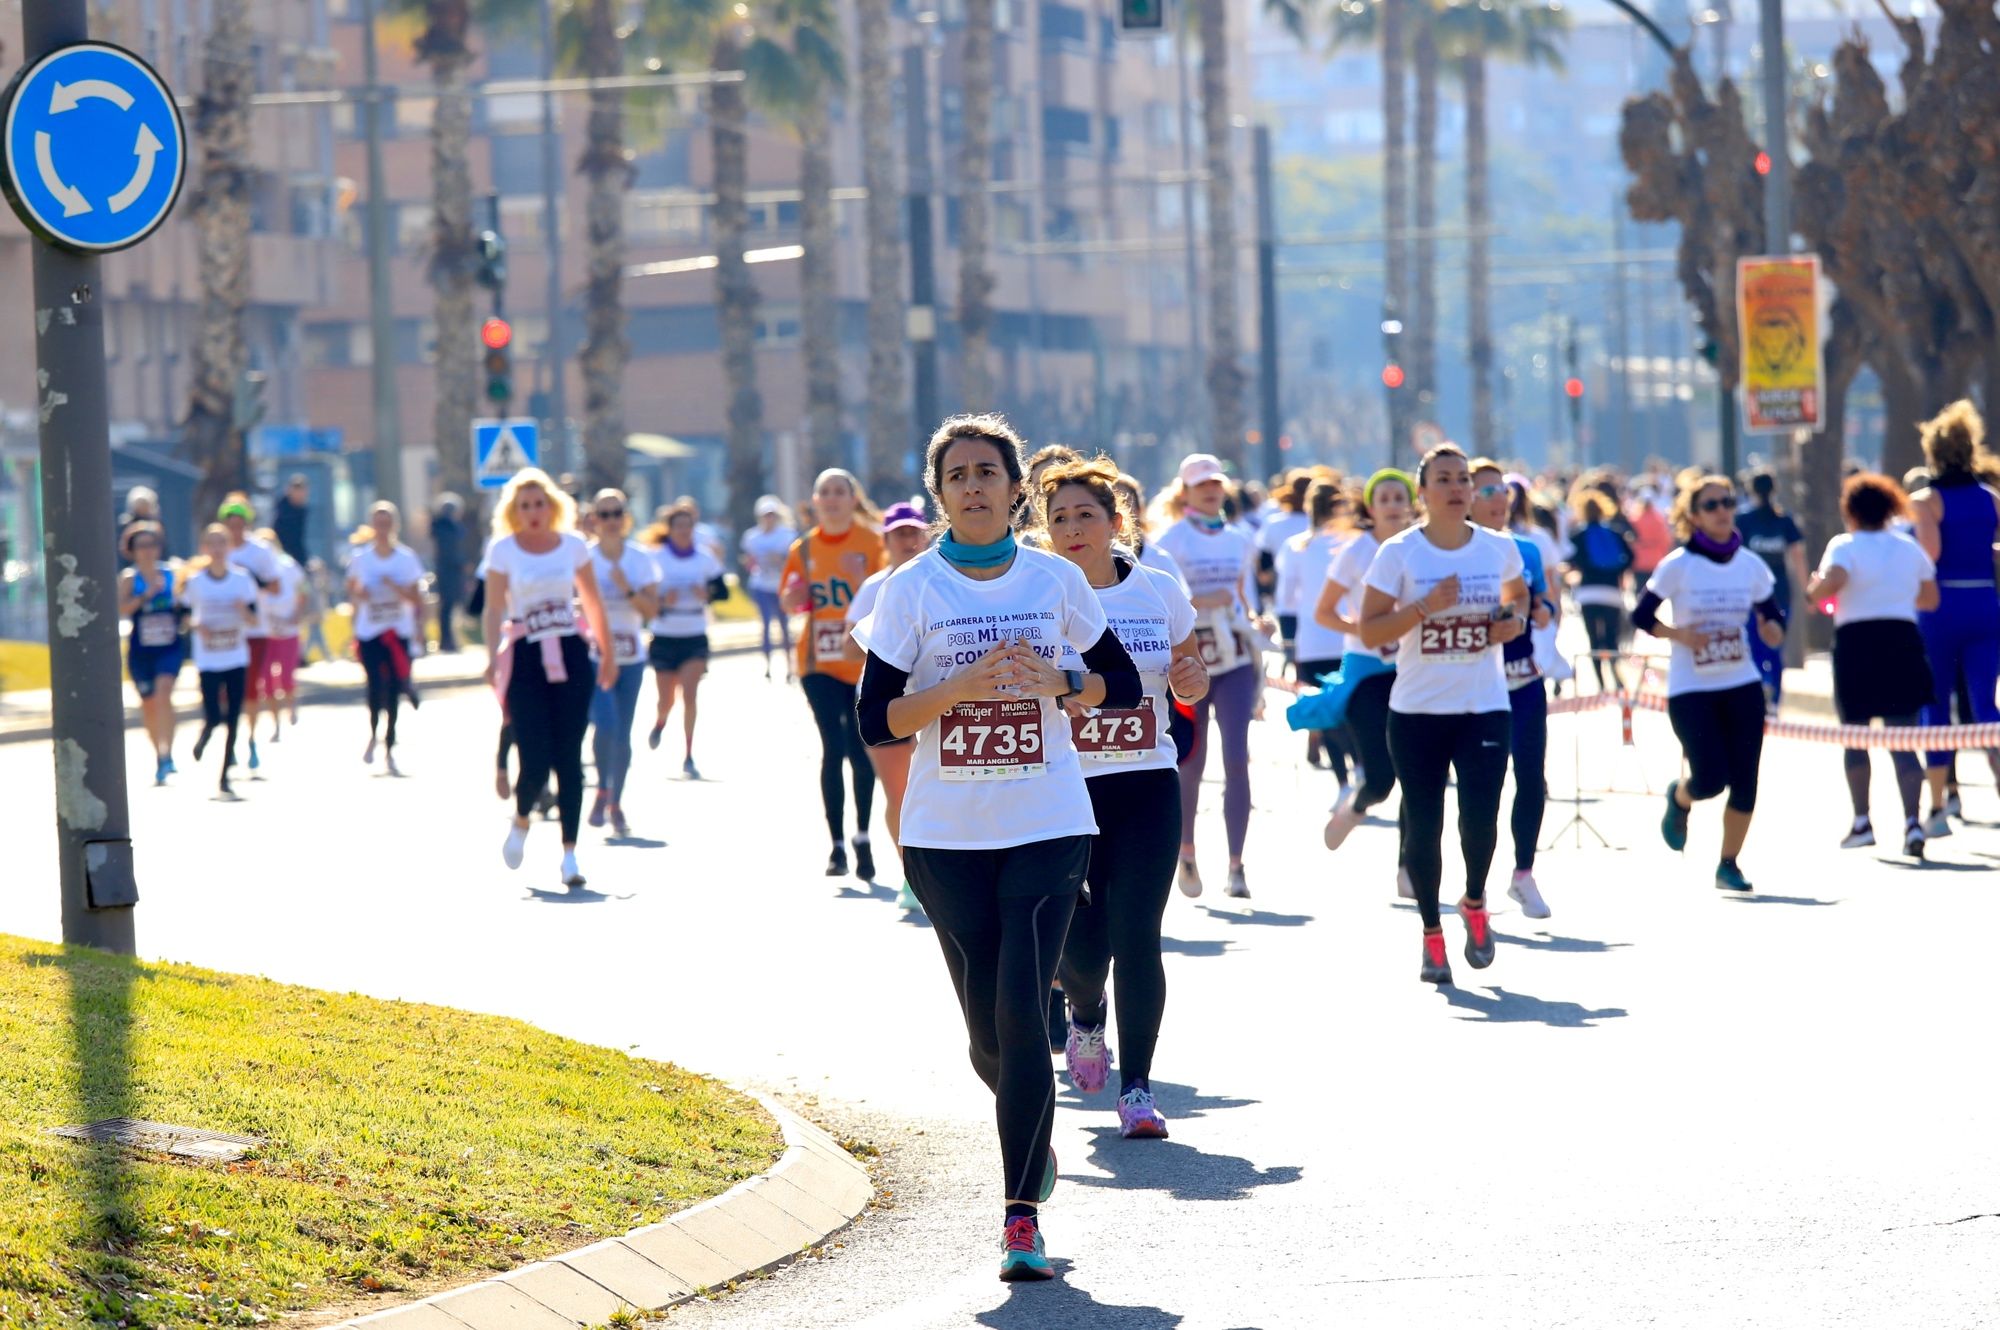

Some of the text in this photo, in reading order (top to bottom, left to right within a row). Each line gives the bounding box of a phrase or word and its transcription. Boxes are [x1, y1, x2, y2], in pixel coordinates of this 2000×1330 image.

[930, 621, 944, 631] VIII
[946, 616, 983, 626] CARRERA
[1000, 614, 1010, 622] LA
[1012, 612, 1038, 621] MUJER
[948, 624, 1042, 646] POR MÍ Y POR
[1121, 628, 1130, 638] Y
[1132, 628, 1156, 638] POR
[1422, 626, 1487, 648] 2153
[1062, 645, 1076, 655] IS
[960, 708, 992, 722] mujer
[1002, 702, 1037, 711] MURCIA
[942, 723, 1040, 755] 4735
[1079, 716, 1143, 743] 473
